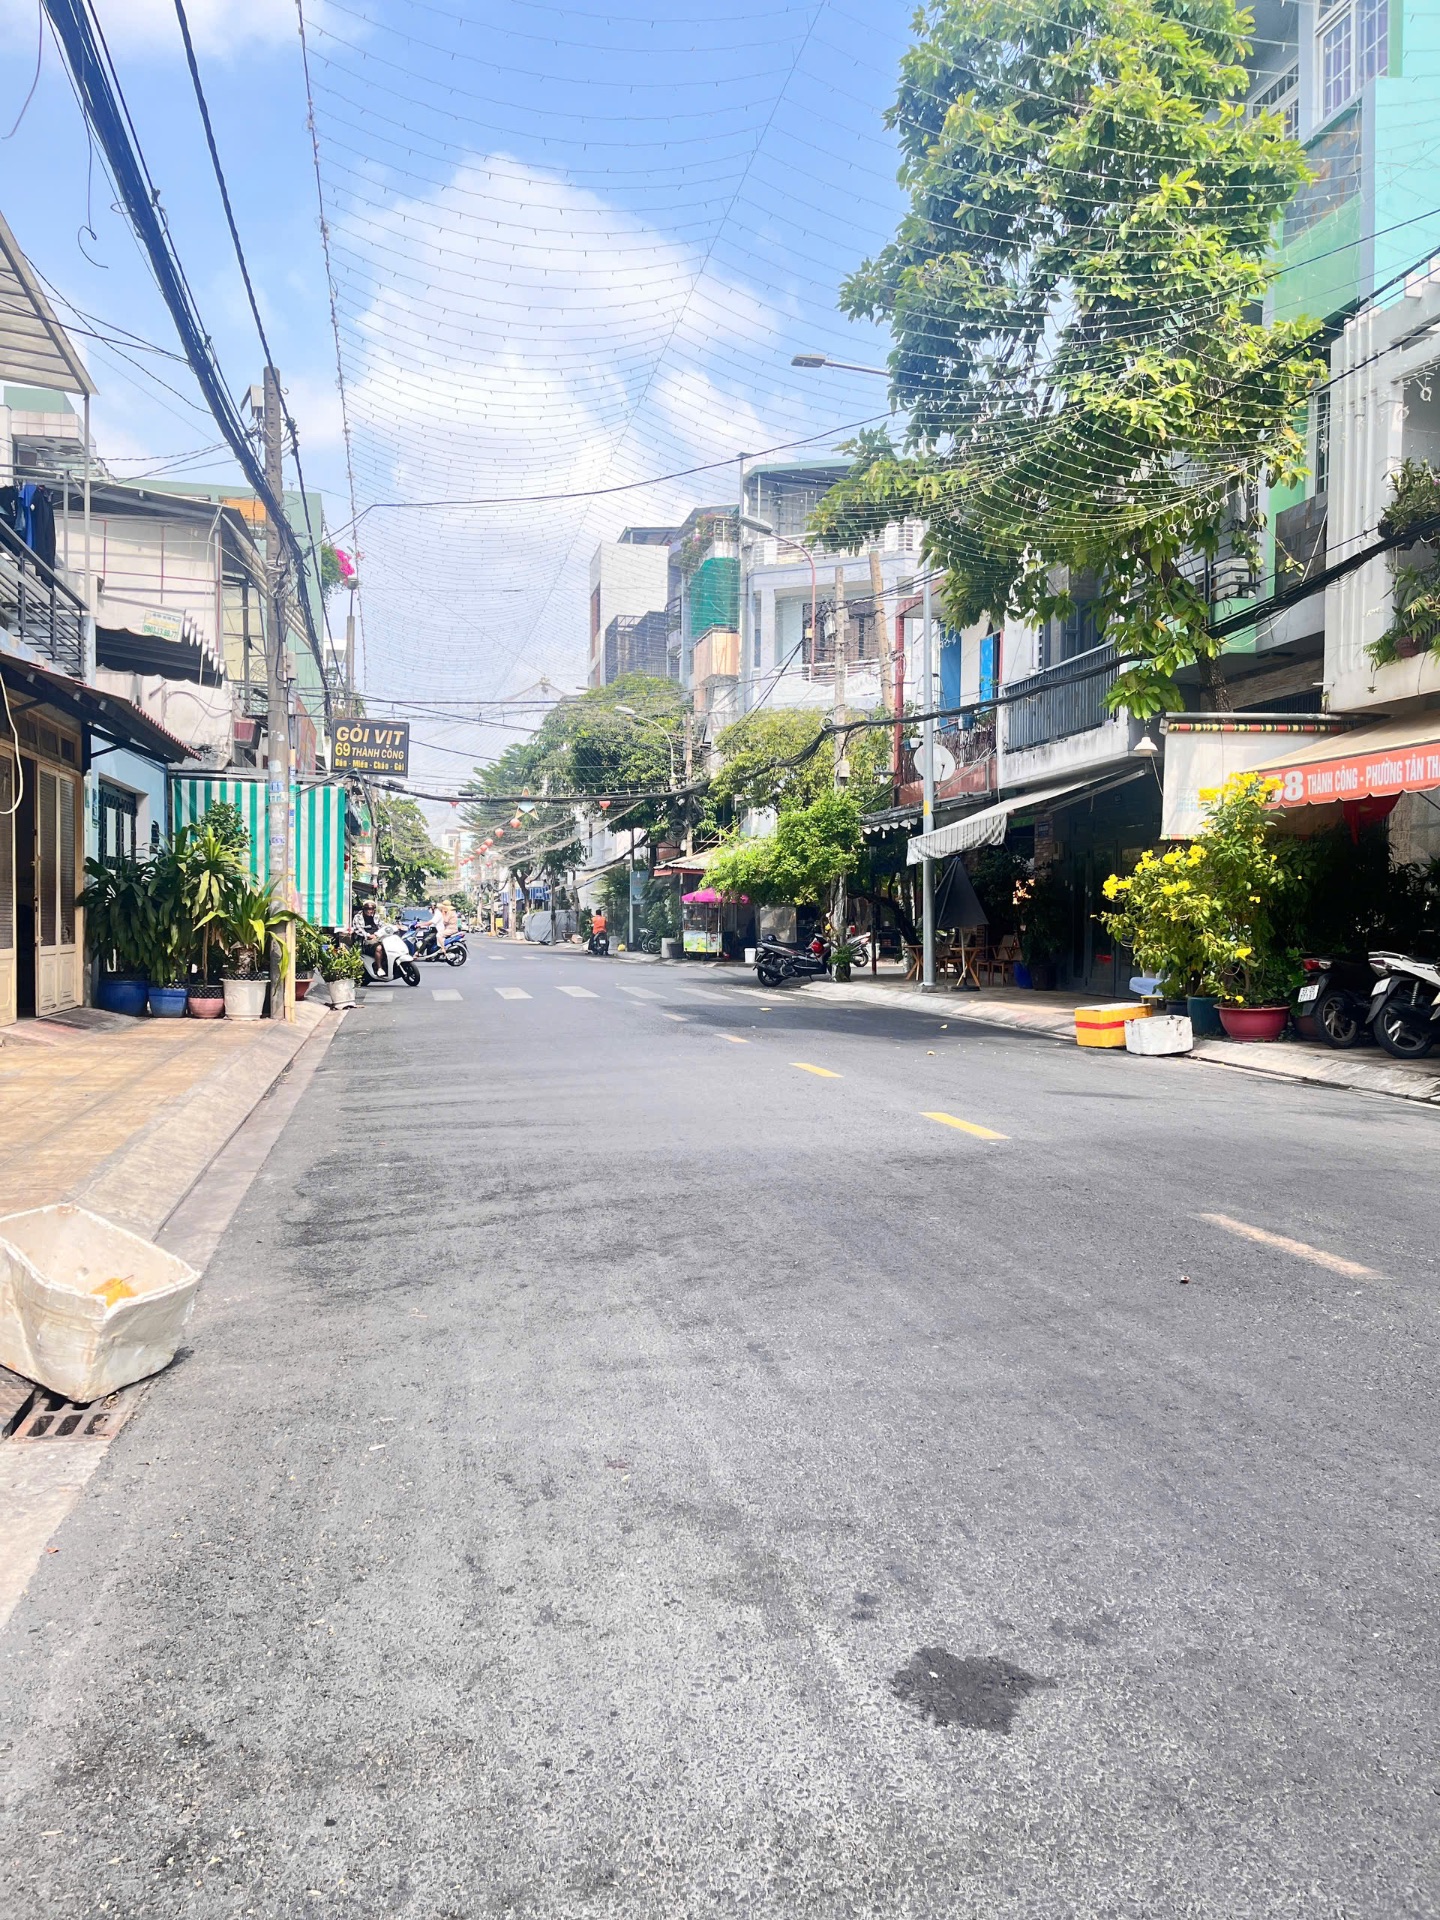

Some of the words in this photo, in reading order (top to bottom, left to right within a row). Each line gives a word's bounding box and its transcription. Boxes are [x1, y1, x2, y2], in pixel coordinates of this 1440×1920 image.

[336, 723, 370, 743] GỎI
[374, 729, 405, 748] VỊT
[335, 742, 351, 757] 69
[352, 746, 380, 758] THÀNH
[381, 748, 404, 760] CÔNG
[1307, 768, 1333, 796] THÀNH
[1334, 765, 1358, 791] CÔNG
[1405, 753, 1424, 781] TÂN
[1427, 755, 1440, 780] TH
